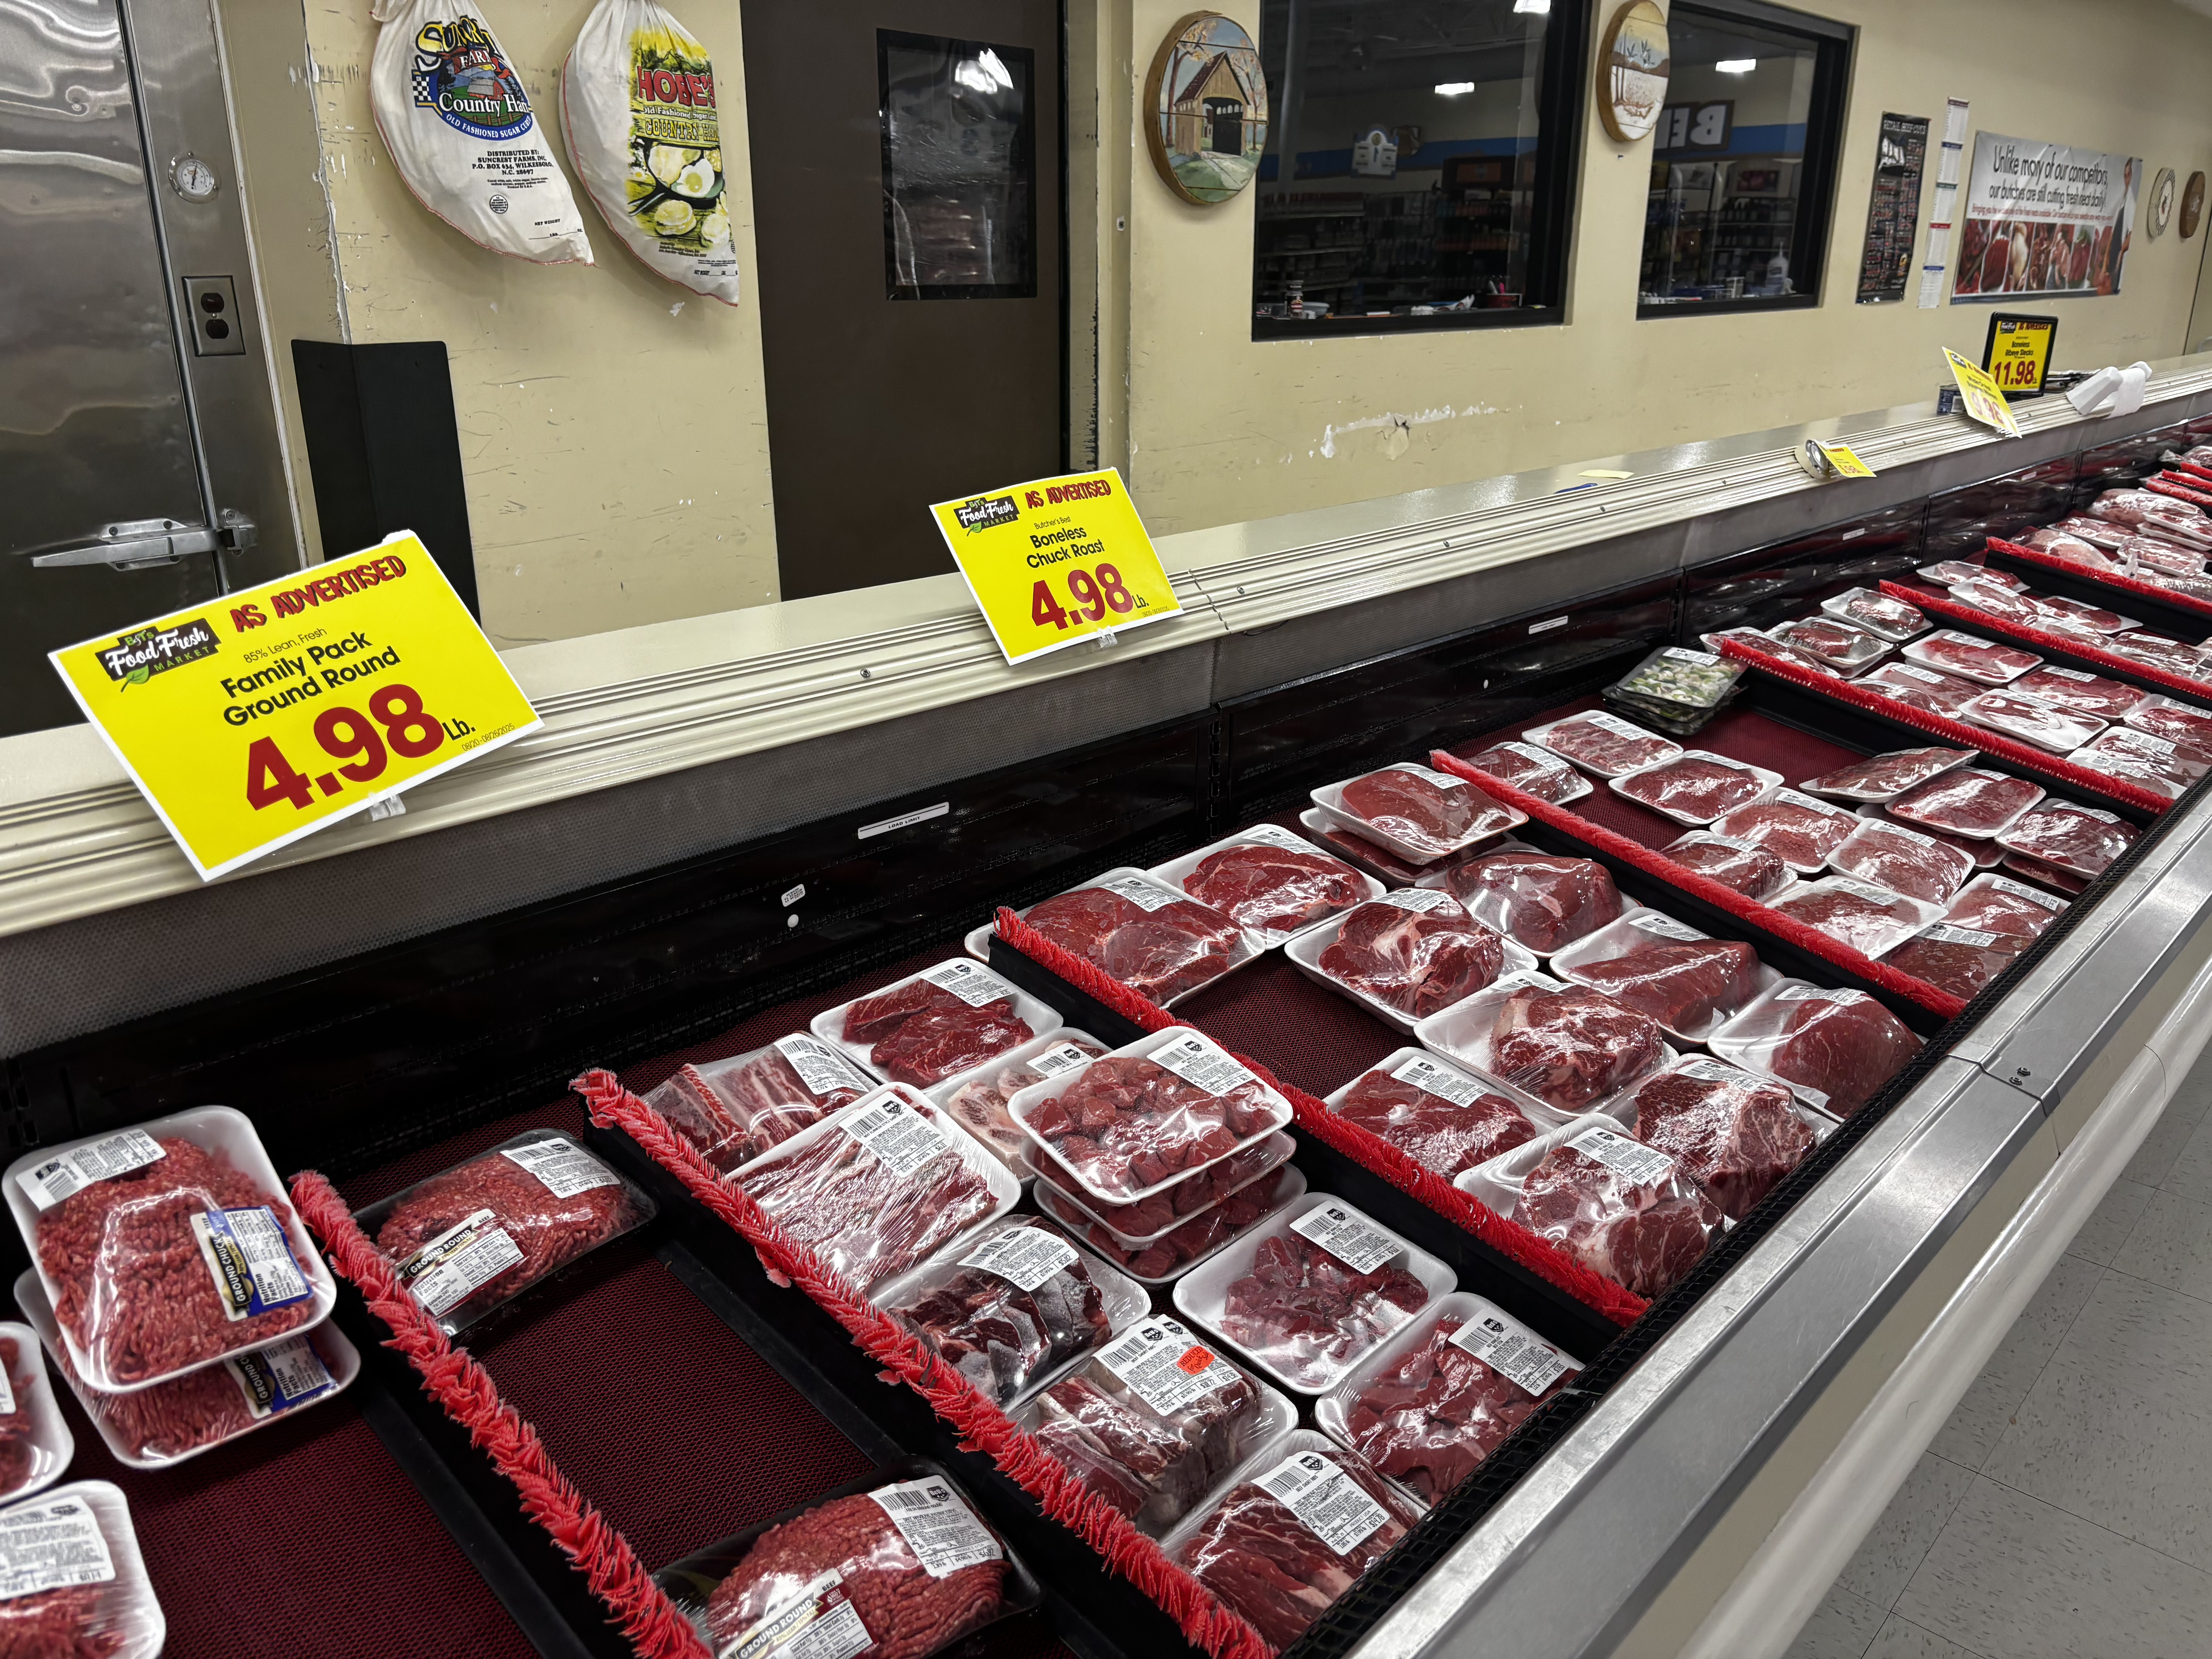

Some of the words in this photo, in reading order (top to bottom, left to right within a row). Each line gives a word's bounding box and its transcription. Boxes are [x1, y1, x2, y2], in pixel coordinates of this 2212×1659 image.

[439, 93, 500, 117] Country
[658, 107, 690, 118] Fashioned
[692, 112, 707, 120] Sugar
[446, 114, 459, 126] OLD
[462, 124, 498, 138] FASHIONED
[500, 126, 520, 137] SUGAR
[520, 115, 531, 131] CURED
[646, 118, 699, 140] COUNTRY
[1994, 144, 2019, 174] Unlike
[2045, 151, 2056, 179] of
[2055, 163, 2069, 181] our
[1989, 184, 2000, 199] our
[2027, 187, 2036, 201] are
[2037, 182, 2047, 202] still
[2066, 185, 2078, 205] fresh
[1995, 361, 2035, 385] 11.98
[1025, 491, 1044, 509] AS
[1046, 480, 1111, 504] ADVERTISED
[959, 507, 988, 526] Food
[986, 501, 1014, 518] Fresh
[984, 515, 1014, 527] MARKET
[1034, 519, 1060, 529] Butcher's
[1030, 527, 1087, 549] Boneless
[1027, 547, 1071, 568] Chuck
[1070, 539, 1105, 558] Roast
[230, 604, 267, 632] AS
[271, 556, 407, 618] ADVERTISED
[1032, 563, 1133, 630] 4.98
[1132, 594, 1149, 608] Lb.
[105, 641, 160, 676] Food
[158, 626, 209, 655] Fresh
[244, 649, 268, 663] 85%
[268, 638, 300, 654] Lean,
[298, 627, 327, 643] Fresh
[153, 646, 211, 672] MARKET
[220, 656, 307, 698] Family
[306, 632, 373, 666] Pack
[224, 677, 323, 726] Ground
[321, 646, 401, 689] Round
[247, 684, 445, 811] 4.98
[442, 718, 476, 741] Lb.
[462, 739, 480, 751] 08/20
[482, 723, 515, 742] 08/26/2025
[905, 816, 921, 824] LIMIT
[213, 1234, 232, 1264] CHUCK
[410, 1247, 444, 1273] GROUND
[443, 1230, 471, 1250] ROUND
[223, 1262, 246, 1303] GROUND
[255, 1273, 271, 1304] Nutrition
[414, 1269, 444, 1292] Nutrition
[419, 1280, 438, 1296] Facts
[428, 1294, 443, 1306] Calories
[1145, 1329, 1158, 1337] Bell's
[1180, 1347, 1203, 1367] REDUCED
[243, 1366, 269, 1400] GROUND
[1180, 1379, 1196, 1389] PRODUCT
[1350, 1515, 1364, 1527] PRODUCT
[822, 1580, 836, 1591] BEEF
[740, 1624, 780, 1659] GROUND
[780, 1599, 813, 1625] ROUND
